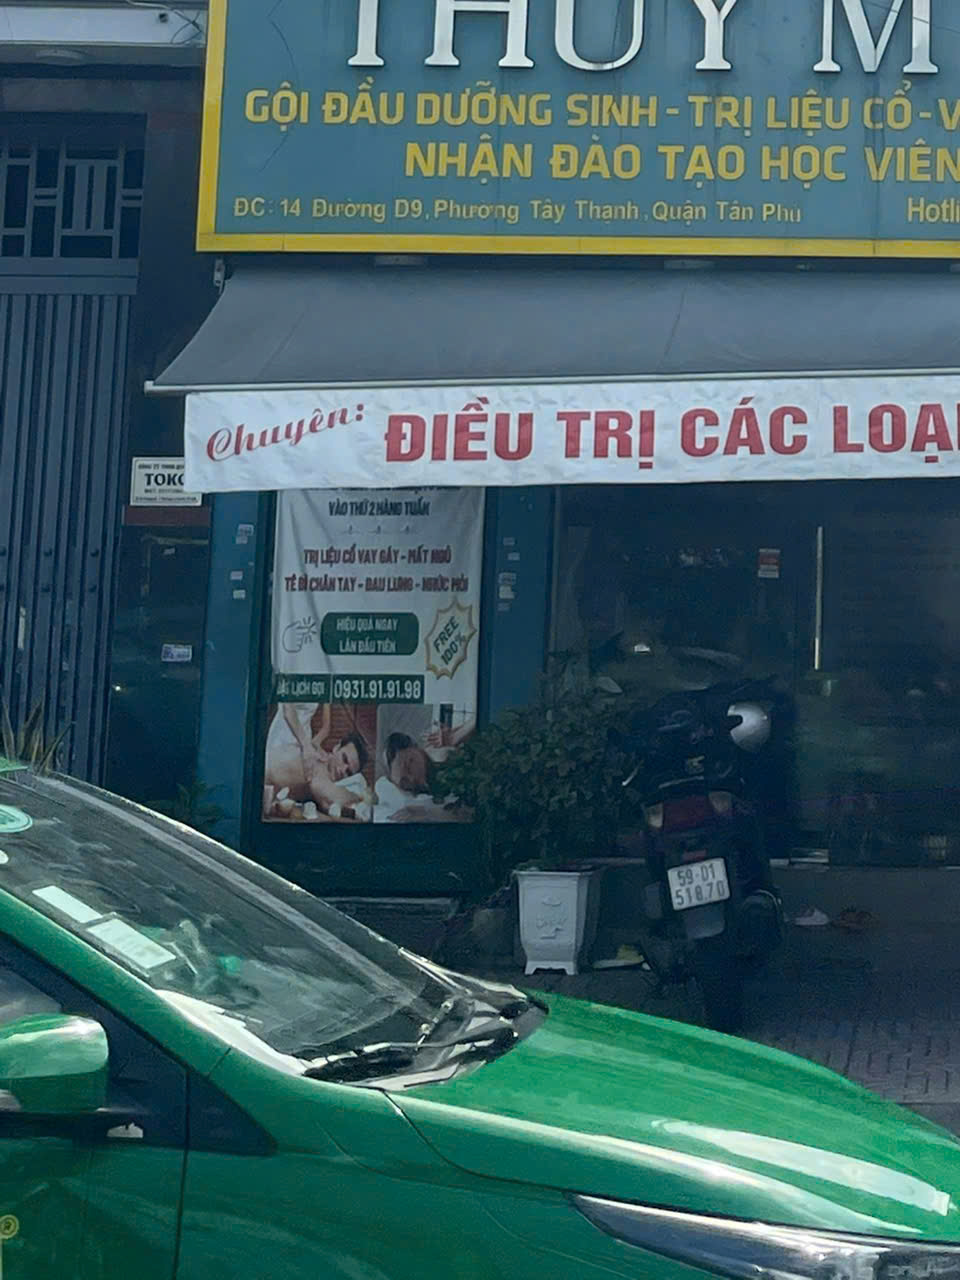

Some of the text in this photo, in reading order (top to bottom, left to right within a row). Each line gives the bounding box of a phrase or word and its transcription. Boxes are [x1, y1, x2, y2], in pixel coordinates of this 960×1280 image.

[245, 81, 309, 131] GỘI
[322, 76, 405, 124] ĐẦU
[416, 80, 552, 126] DƯỠNG
[566, 93, 657, 127] SINH
[687, 95, 752, 137] TRỊ
[766, 89, 850, 136] LIỆU
[864, 80, 912, 130] CỔ
[405, 133, 533, 184] NHẬN
[549, 134, 641, 179] ĐÀO
[657, 144, 745, 188] TẠO
[761, 145, 847, 189] HỌC
[280, 198, 302, 216] 14
[529, 199, 566, 223] Tây
[206, 403, 365, 462] Chuyên:
[384, 396, 535, 462] ĐIỀU
[556, 410, 655, 469] TRỊ
[680, 396, 808, 457] CÁC
[433, 615, 459, 653] FREE
[334, 679, 422, 699] 0931.91.91.98
